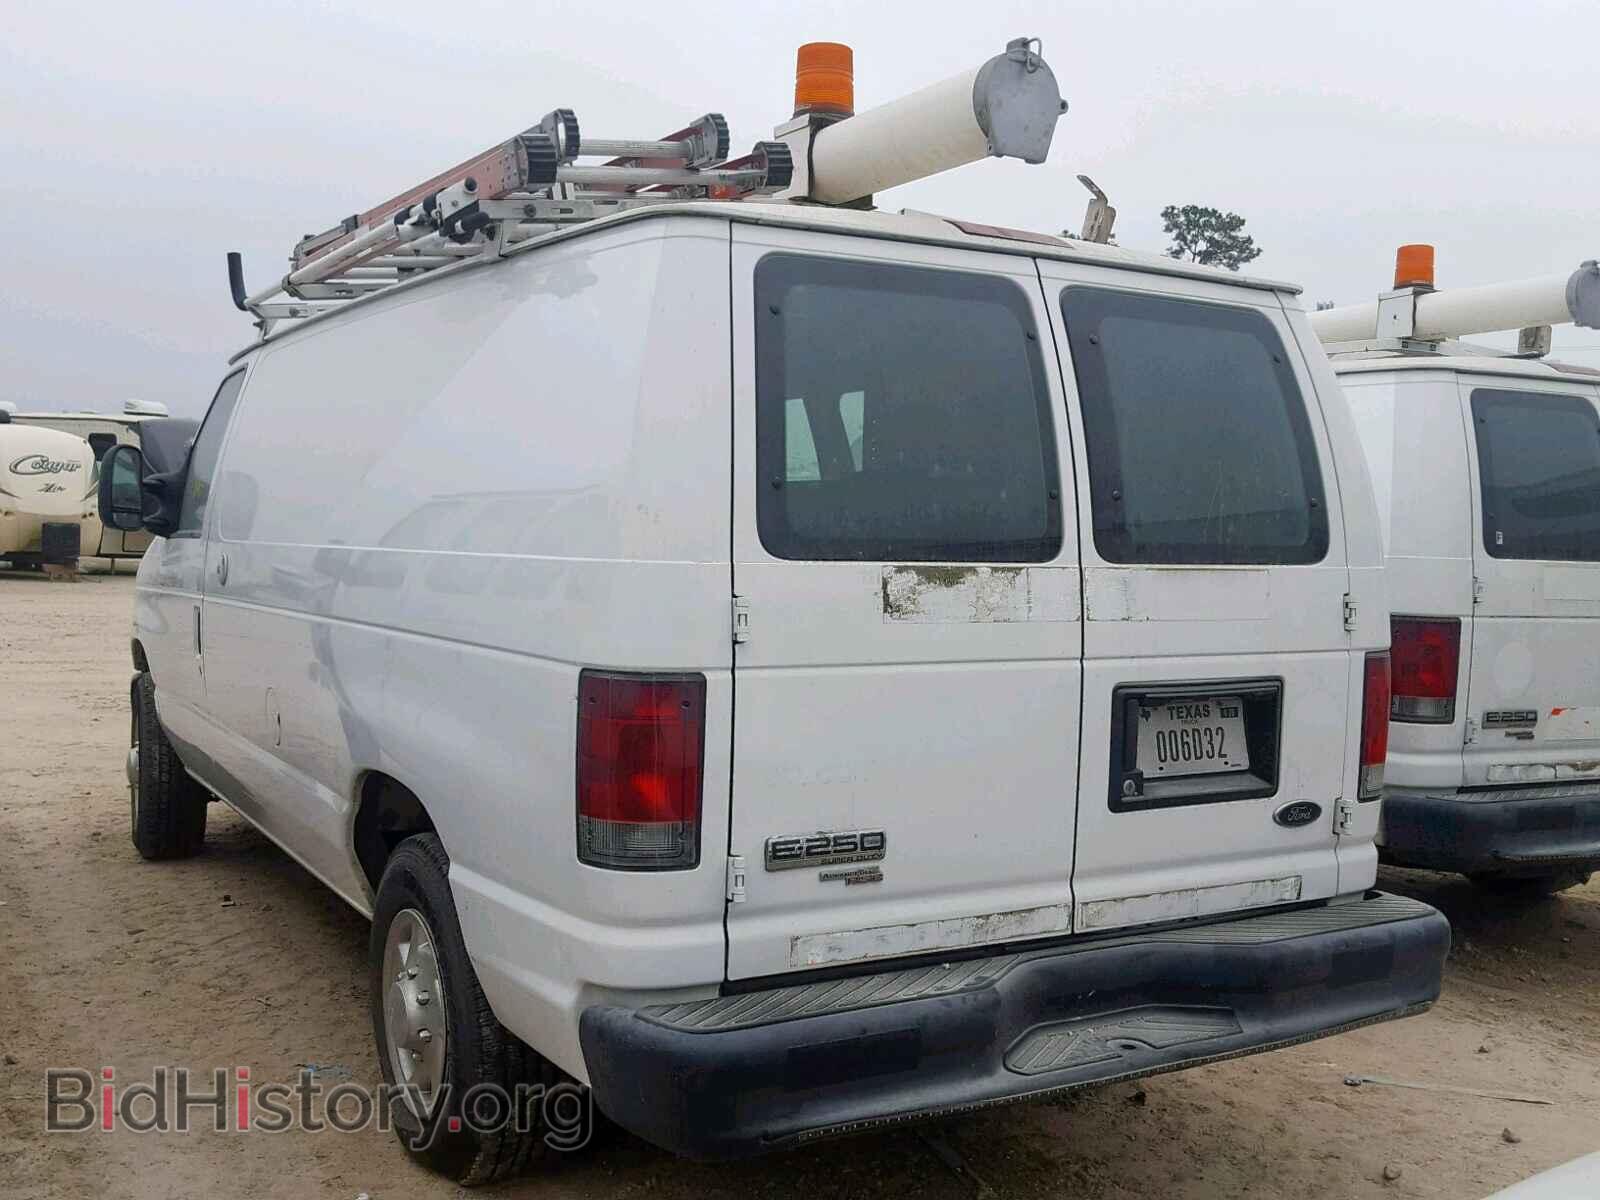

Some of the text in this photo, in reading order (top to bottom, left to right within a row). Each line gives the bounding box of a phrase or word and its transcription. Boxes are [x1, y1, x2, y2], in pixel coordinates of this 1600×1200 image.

[9, 454, 82, 475] Cougar
[1167, 704, 1211, 721] TEXAS
[1156, 726, 1228, 763] 006D32
[1287, 806, 1313, 822] Ford
